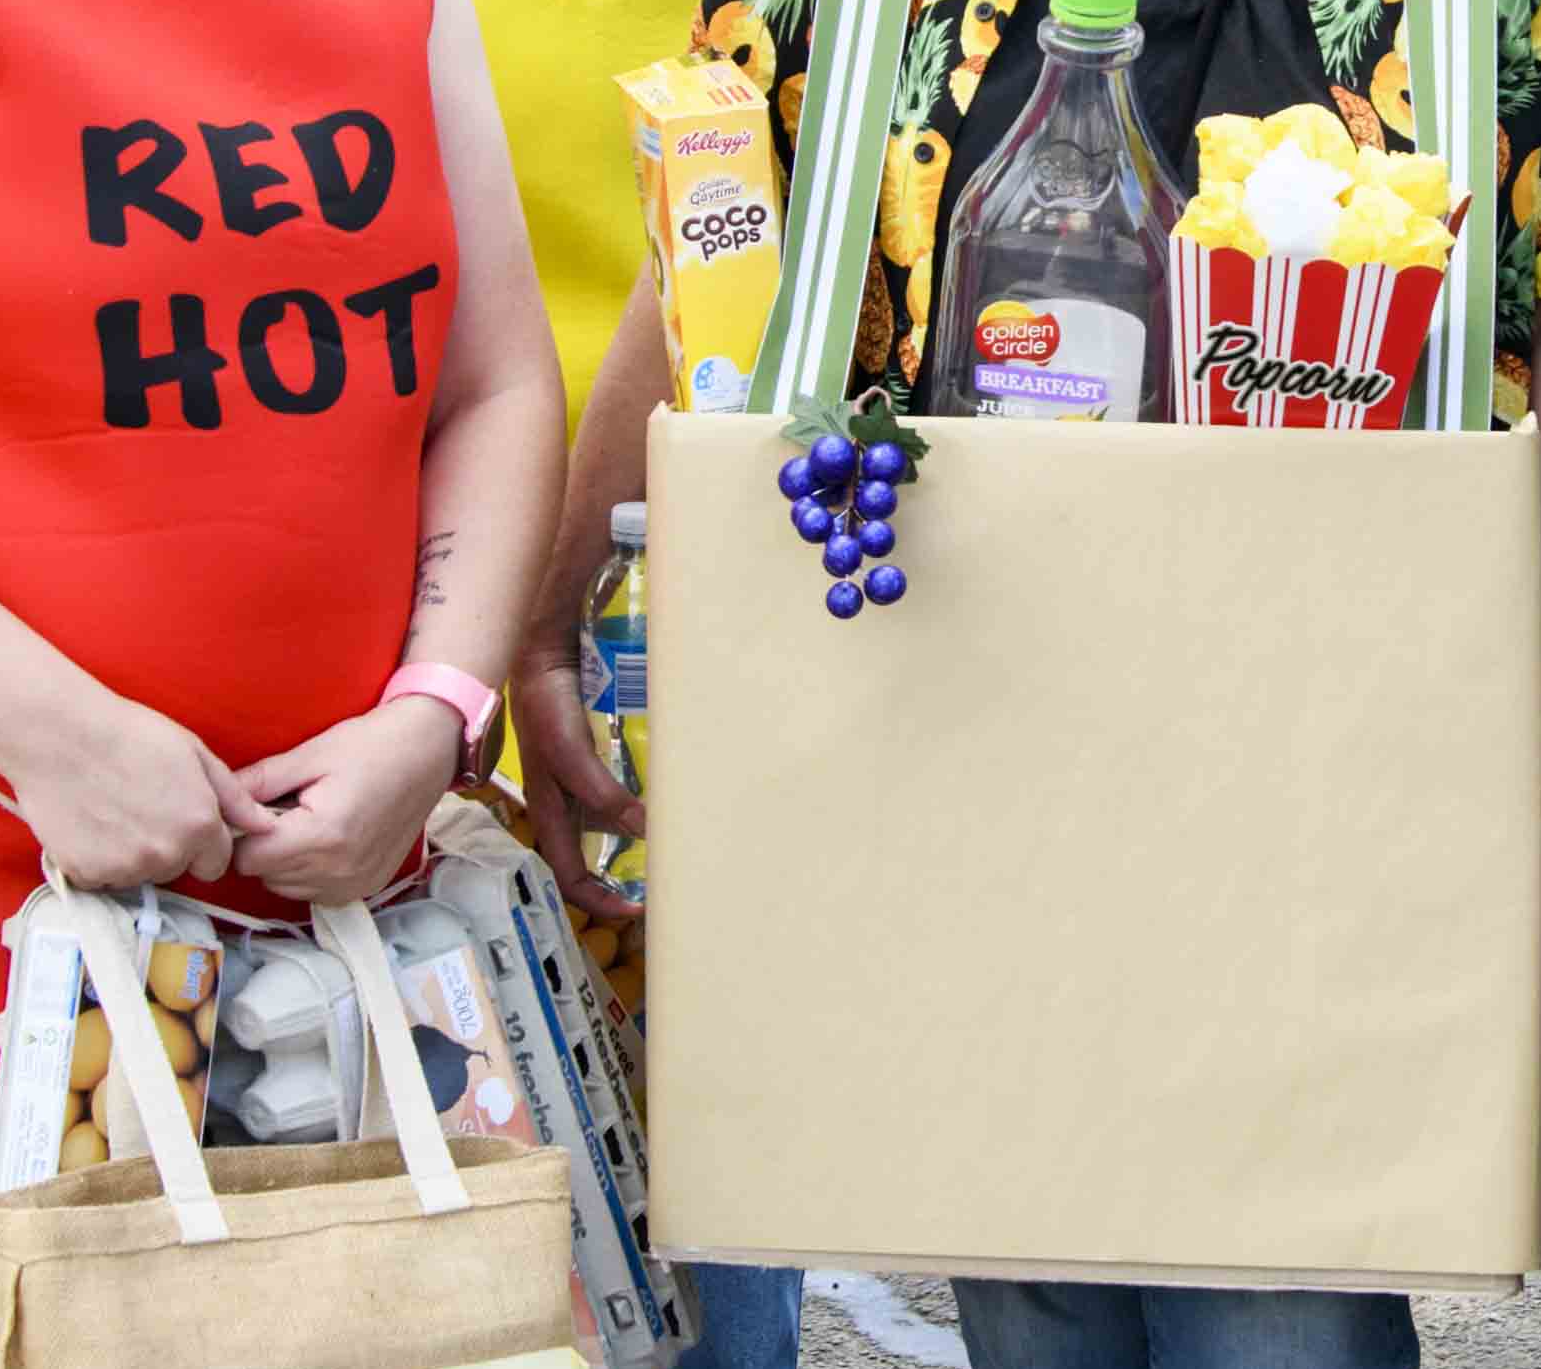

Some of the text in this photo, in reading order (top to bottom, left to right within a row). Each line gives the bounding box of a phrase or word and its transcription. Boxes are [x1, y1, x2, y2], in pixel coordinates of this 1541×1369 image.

[676, 128, 752, 157] Kellogg's
[80, 108, 397, 249] RED
[689, 183, 743, 207] Gaytime
[700, 224, 762, 262] pops
[94, 262, 441, 431] HOT
[980, 319, 1056, 344] golden
[990, 336, 1049, 358] circle
[977, 368, 1107, 401] BREAKFAST
[1193, 323, 1395, 413] Popcorn
[576, 979, 597, 1015] 12
